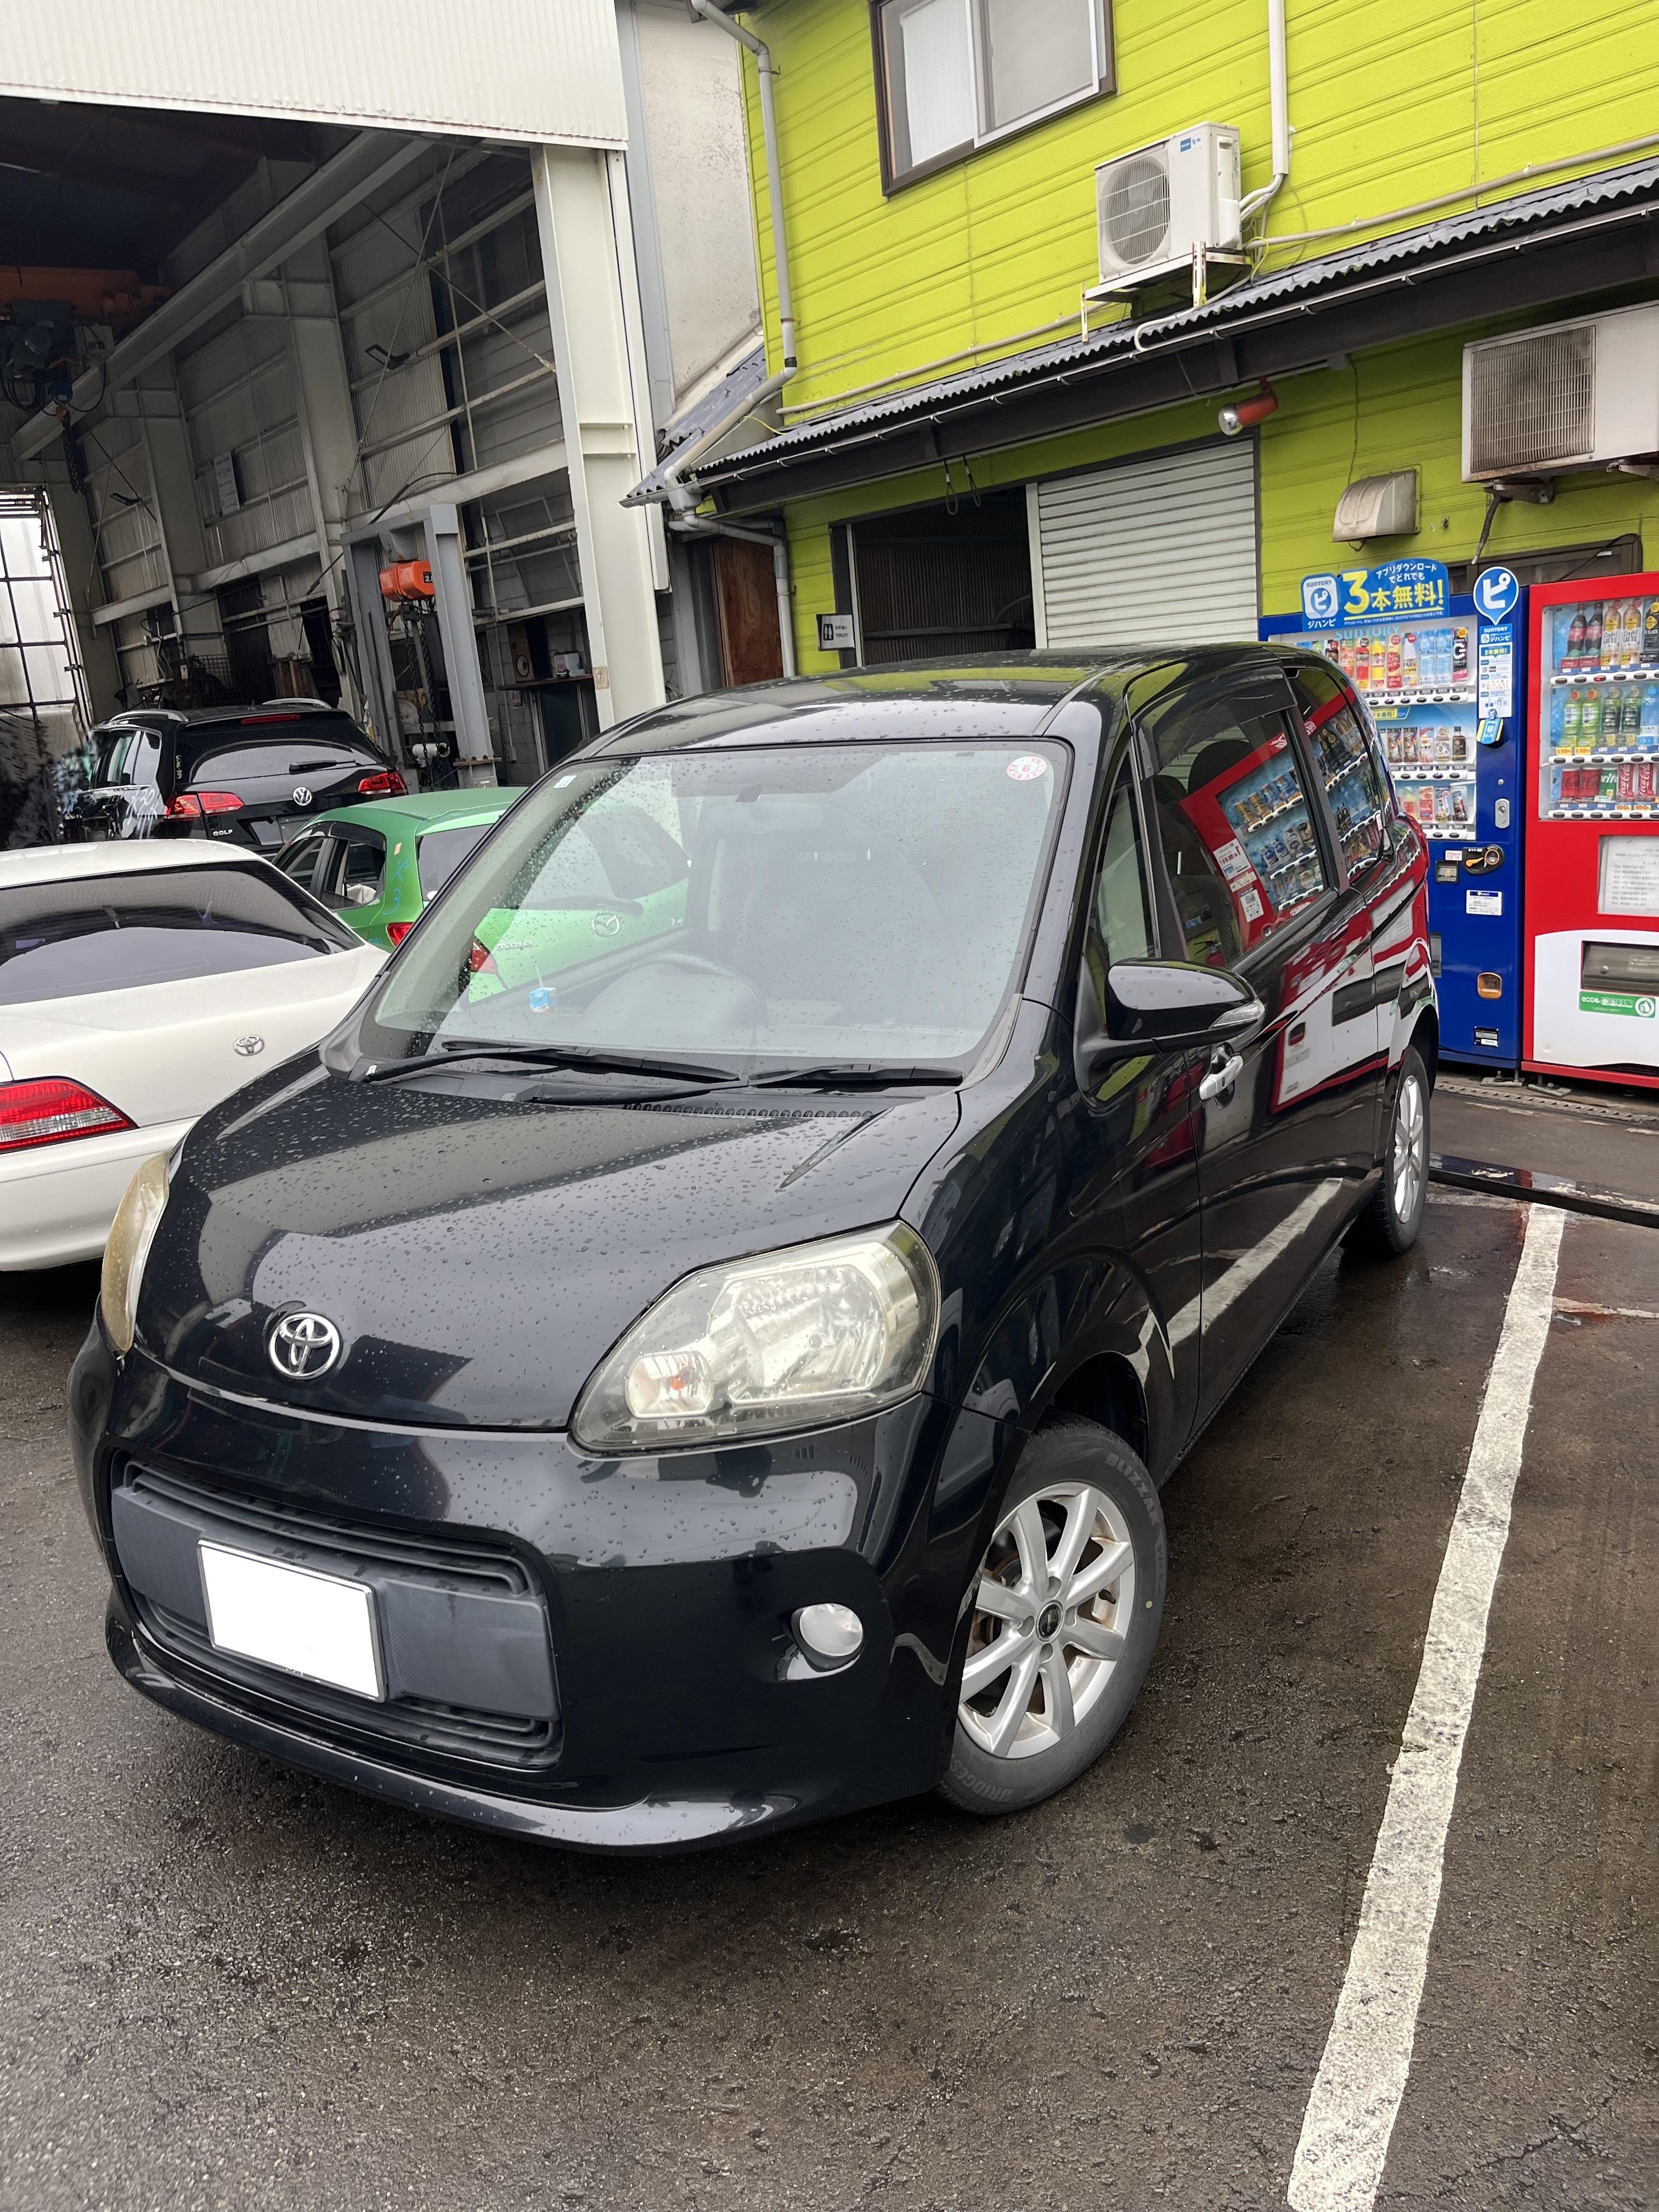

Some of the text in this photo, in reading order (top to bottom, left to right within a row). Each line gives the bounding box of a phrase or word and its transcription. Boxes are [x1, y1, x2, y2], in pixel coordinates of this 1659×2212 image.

[1376, 563, 1437, 579] アプリダウンロード
[1389, 572, 1425, 584] でどれでも
[1307, 618, 1336, 629] ジハンピ
[1335, 625, 1400, 641] SUNTORY
[1104, 1452, 1160, 1527] BLIZZAK
[949, 1758, 1014, 1802] BRIDGES
